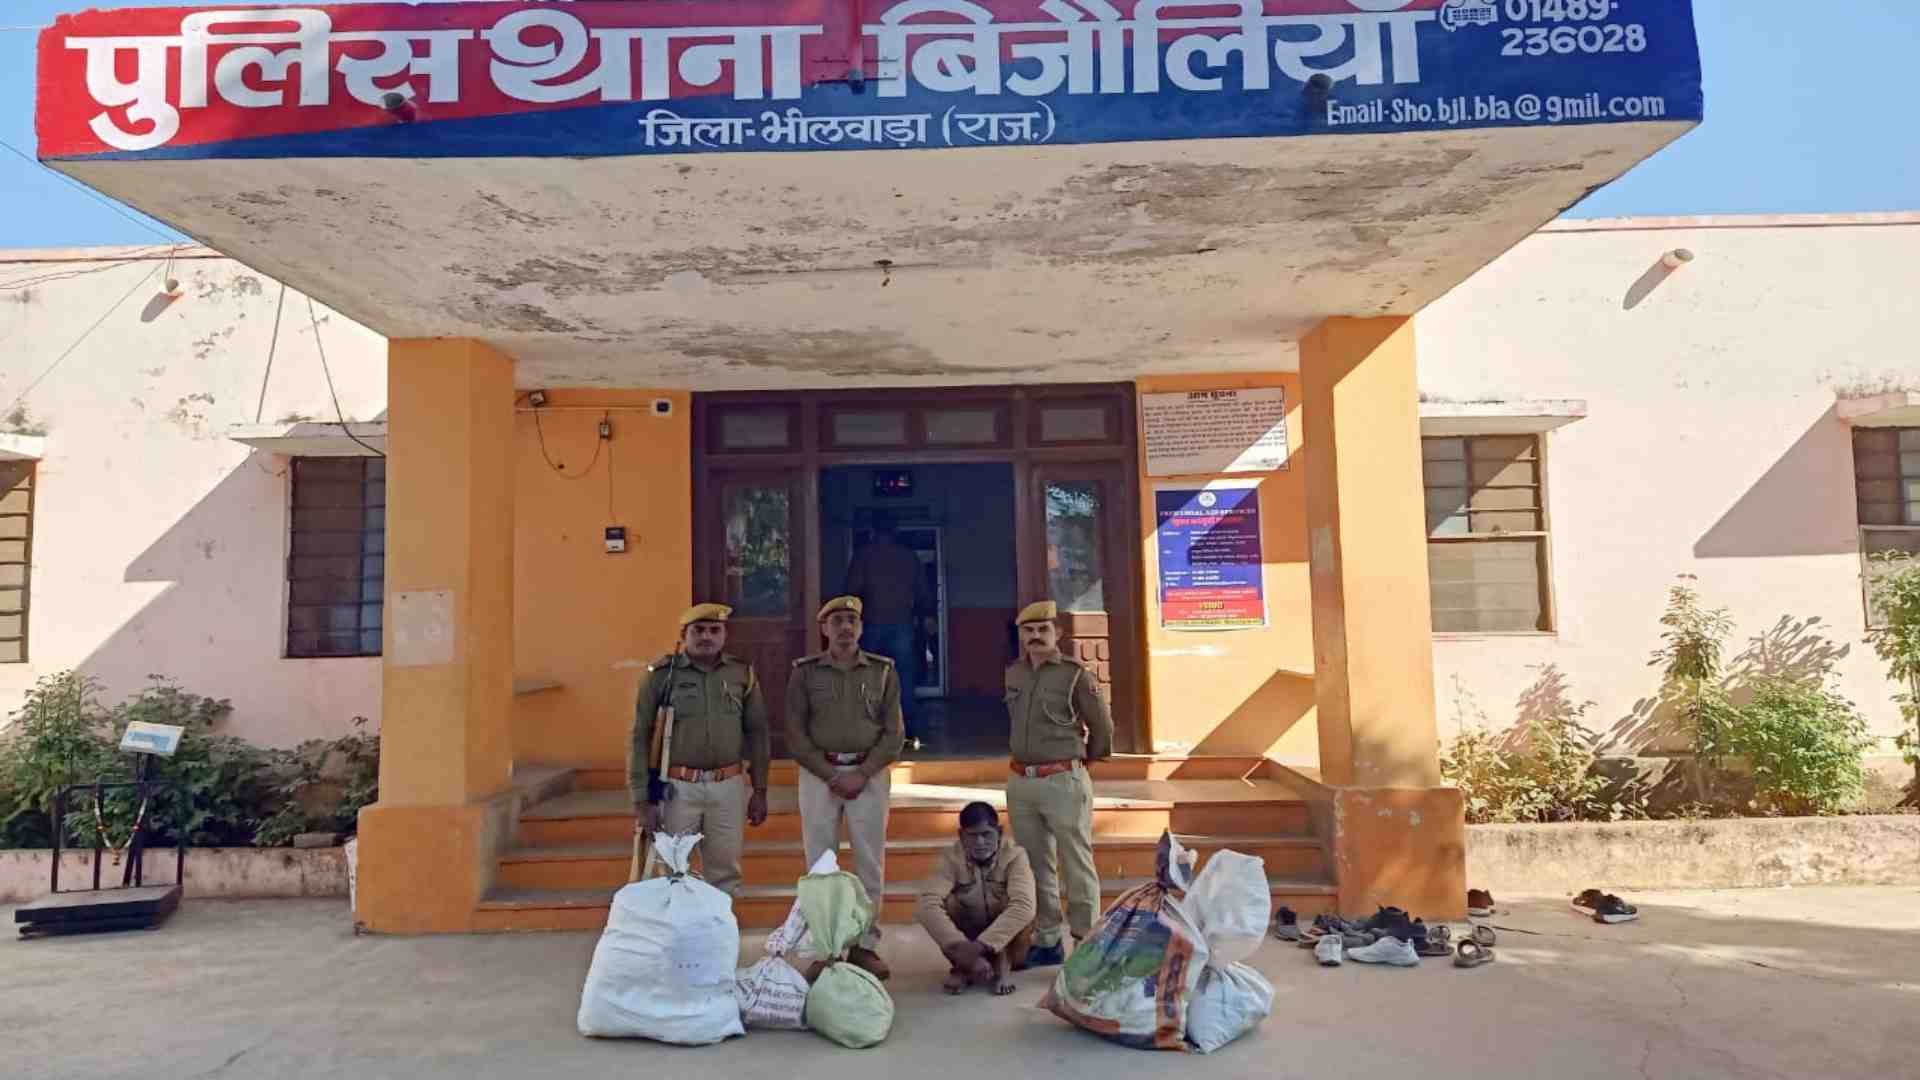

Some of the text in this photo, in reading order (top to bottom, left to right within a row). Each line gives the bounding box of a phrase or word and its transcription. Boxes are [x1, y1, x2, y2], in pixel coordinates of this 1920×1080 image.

[64, 8, 474, 152] पुलिस
[480, 7, 824, 103] थाना
[1500, 24, 1647, 56] 236028
